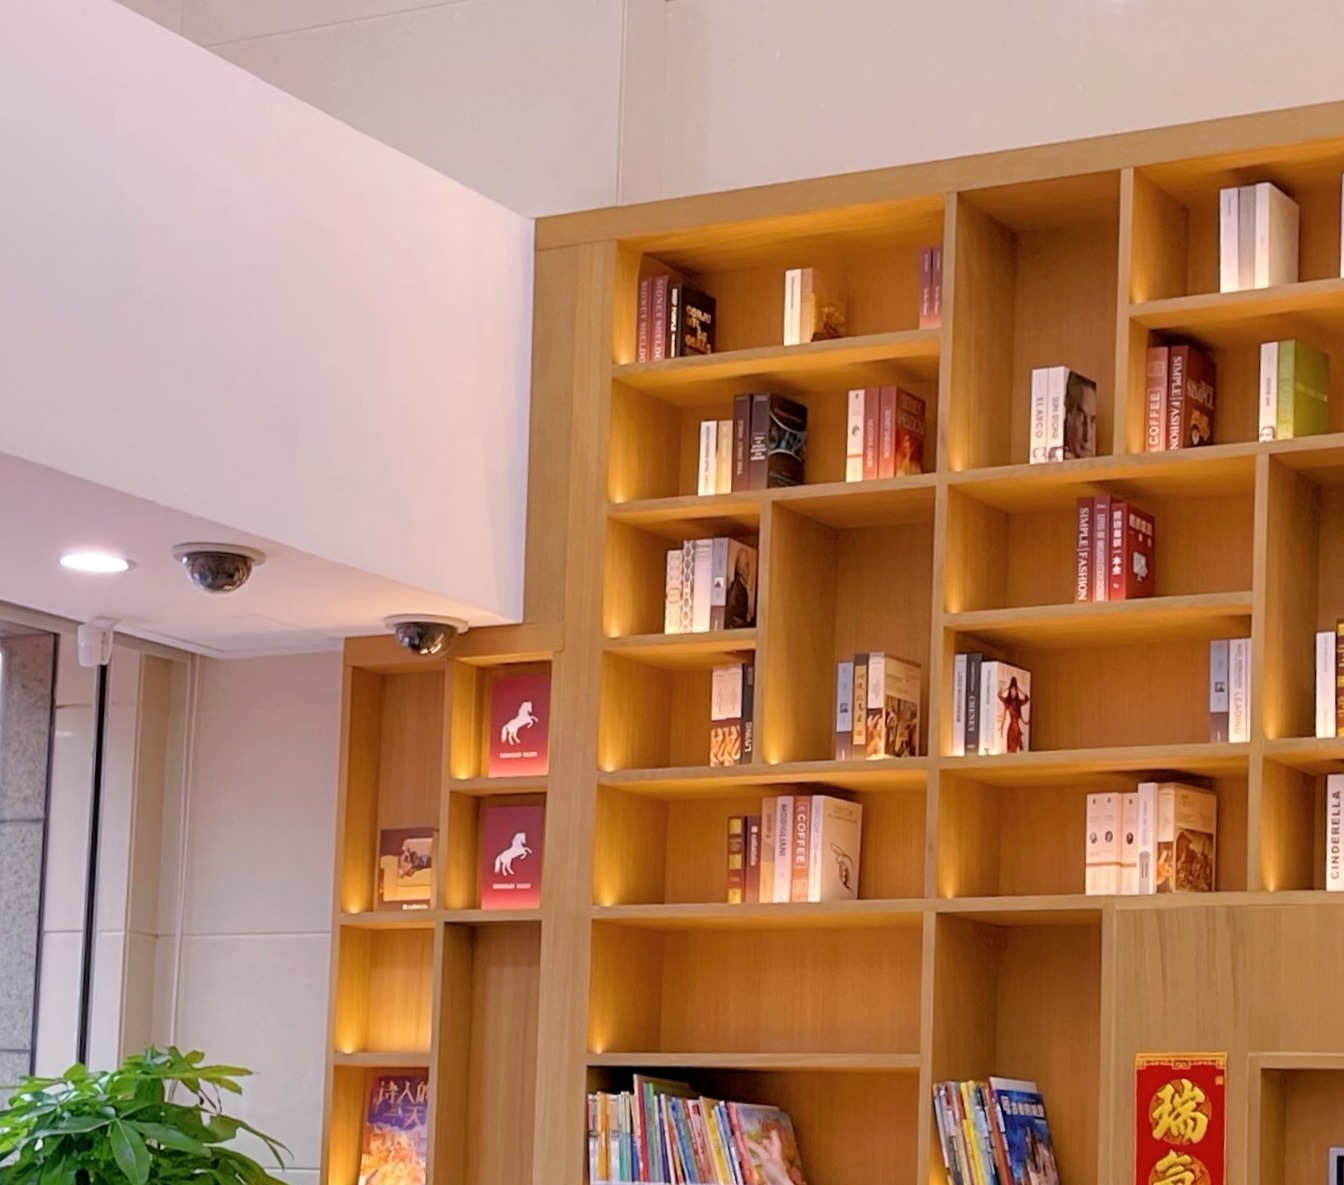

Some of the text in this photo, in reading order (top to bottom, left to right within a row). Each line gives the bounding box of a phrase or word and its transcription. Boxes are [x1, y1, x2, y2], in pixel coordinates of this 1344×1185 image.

[637, 321, 647, 363] SHELDO
[652, 319, 662, 361] SHELDO
[1148, 391, 1160, 445] COFFEE
[778, 803, 787, 857] MODIGLIANI
[796, 813, 806, 865] COFFEE
[1330, 789, 1341, 880] CINDERELLA
